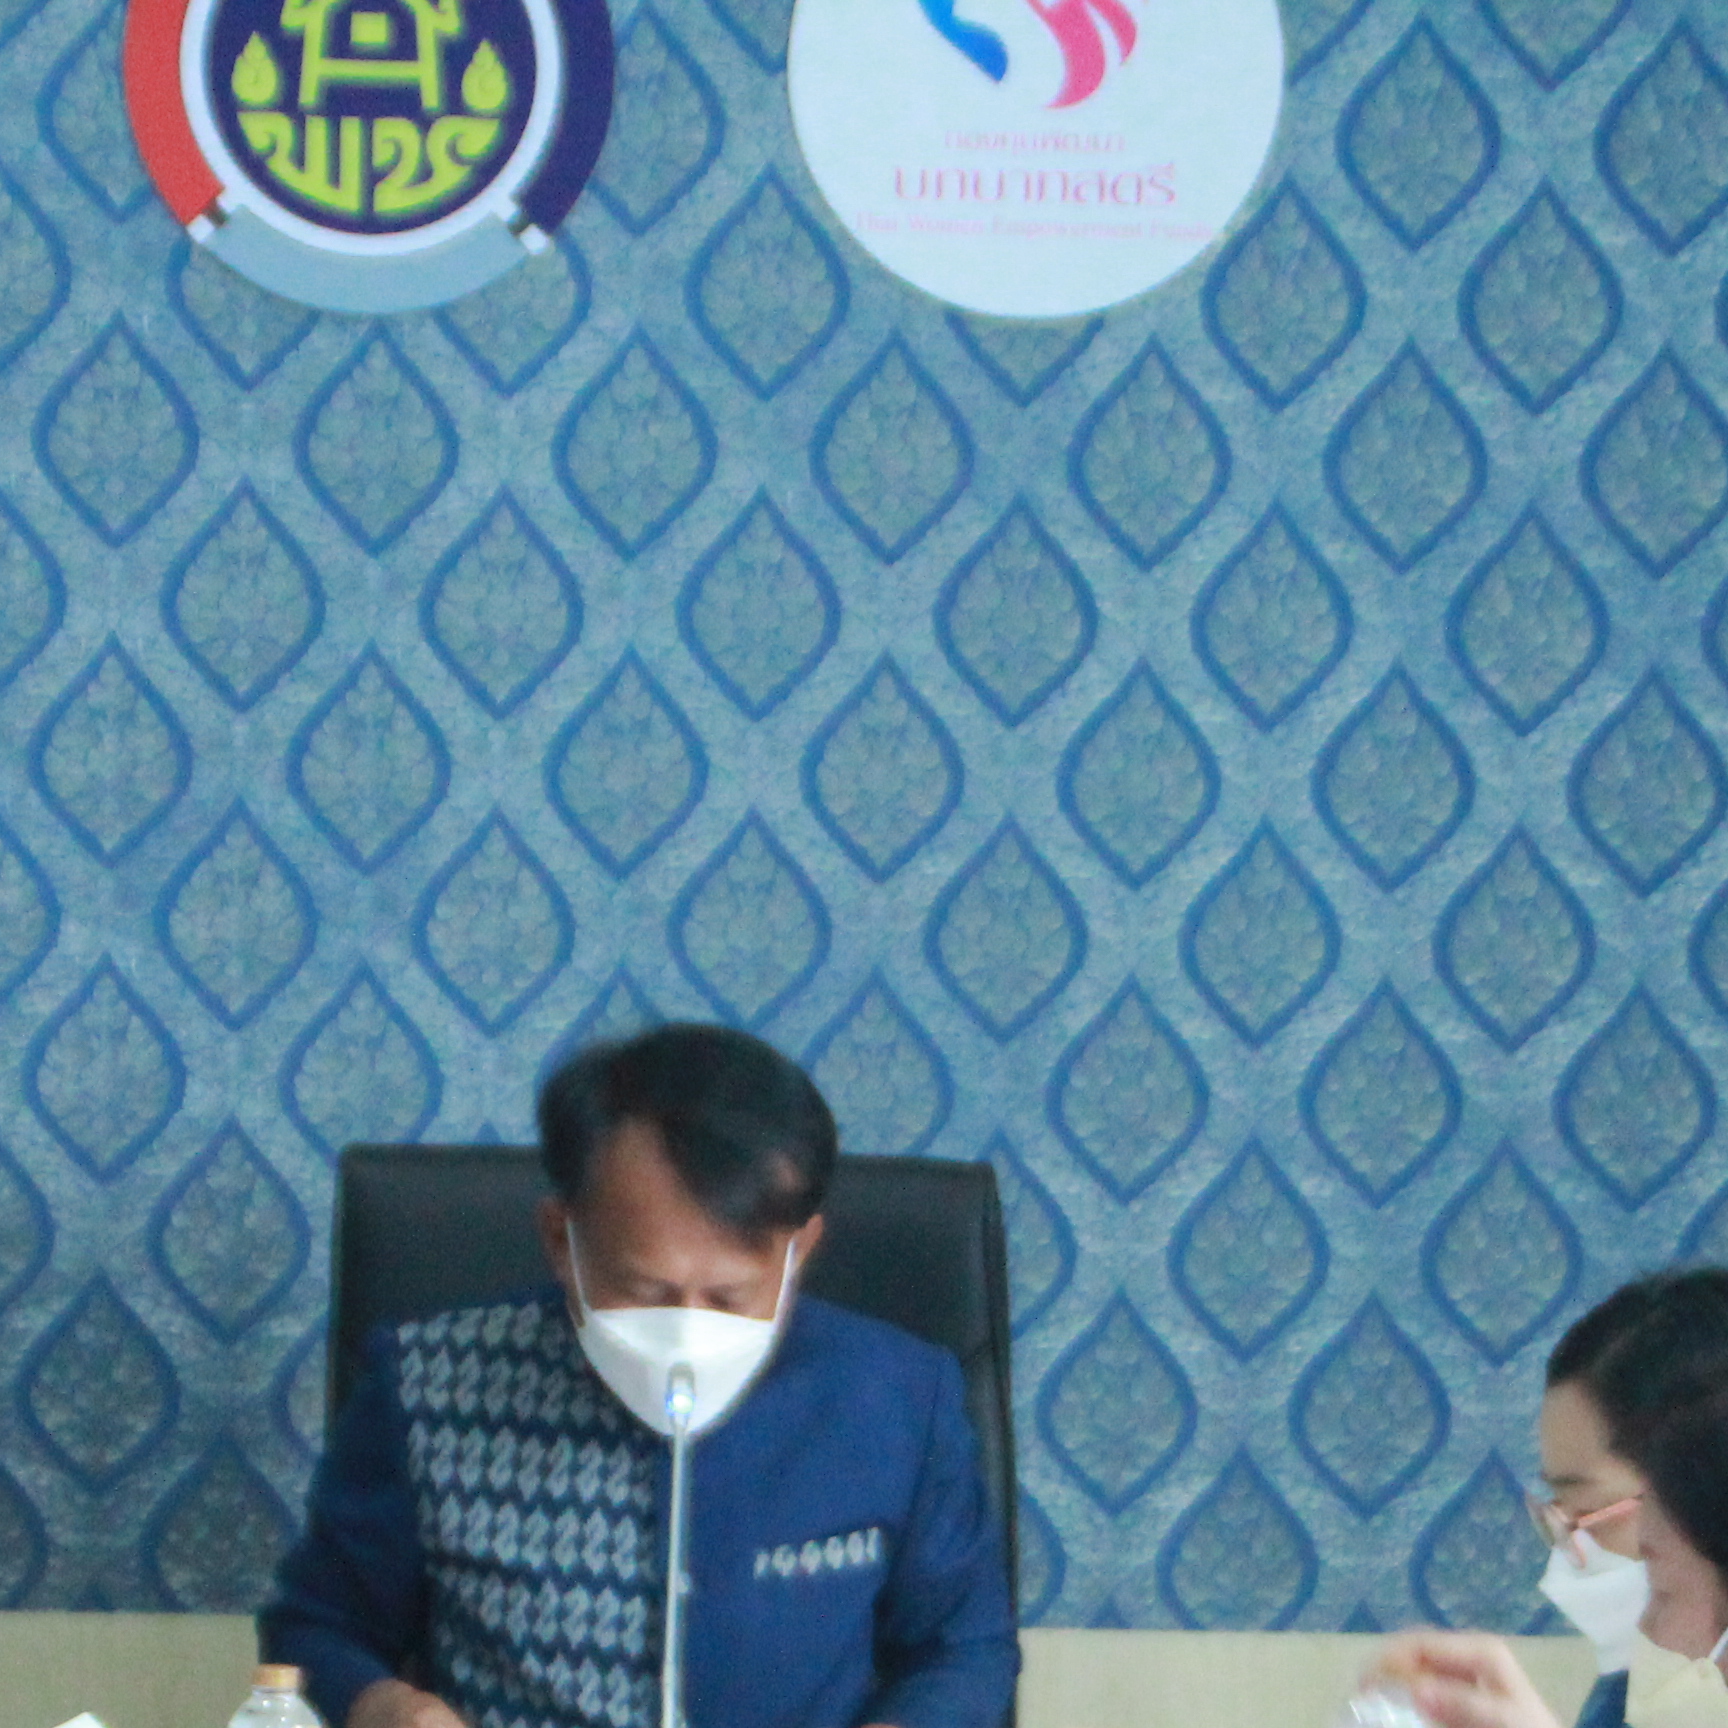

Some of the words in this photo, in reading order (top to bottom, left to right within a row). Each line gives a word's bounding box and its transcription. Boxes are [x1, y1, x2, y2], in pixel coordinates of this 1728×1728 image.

[893, 161, 1178, 204] บทบาทสตรี
[856, 212, 899, 233] Thai
[908, 213, 985, 236] Women
[991, 215, 1144, 241] Empowerment
